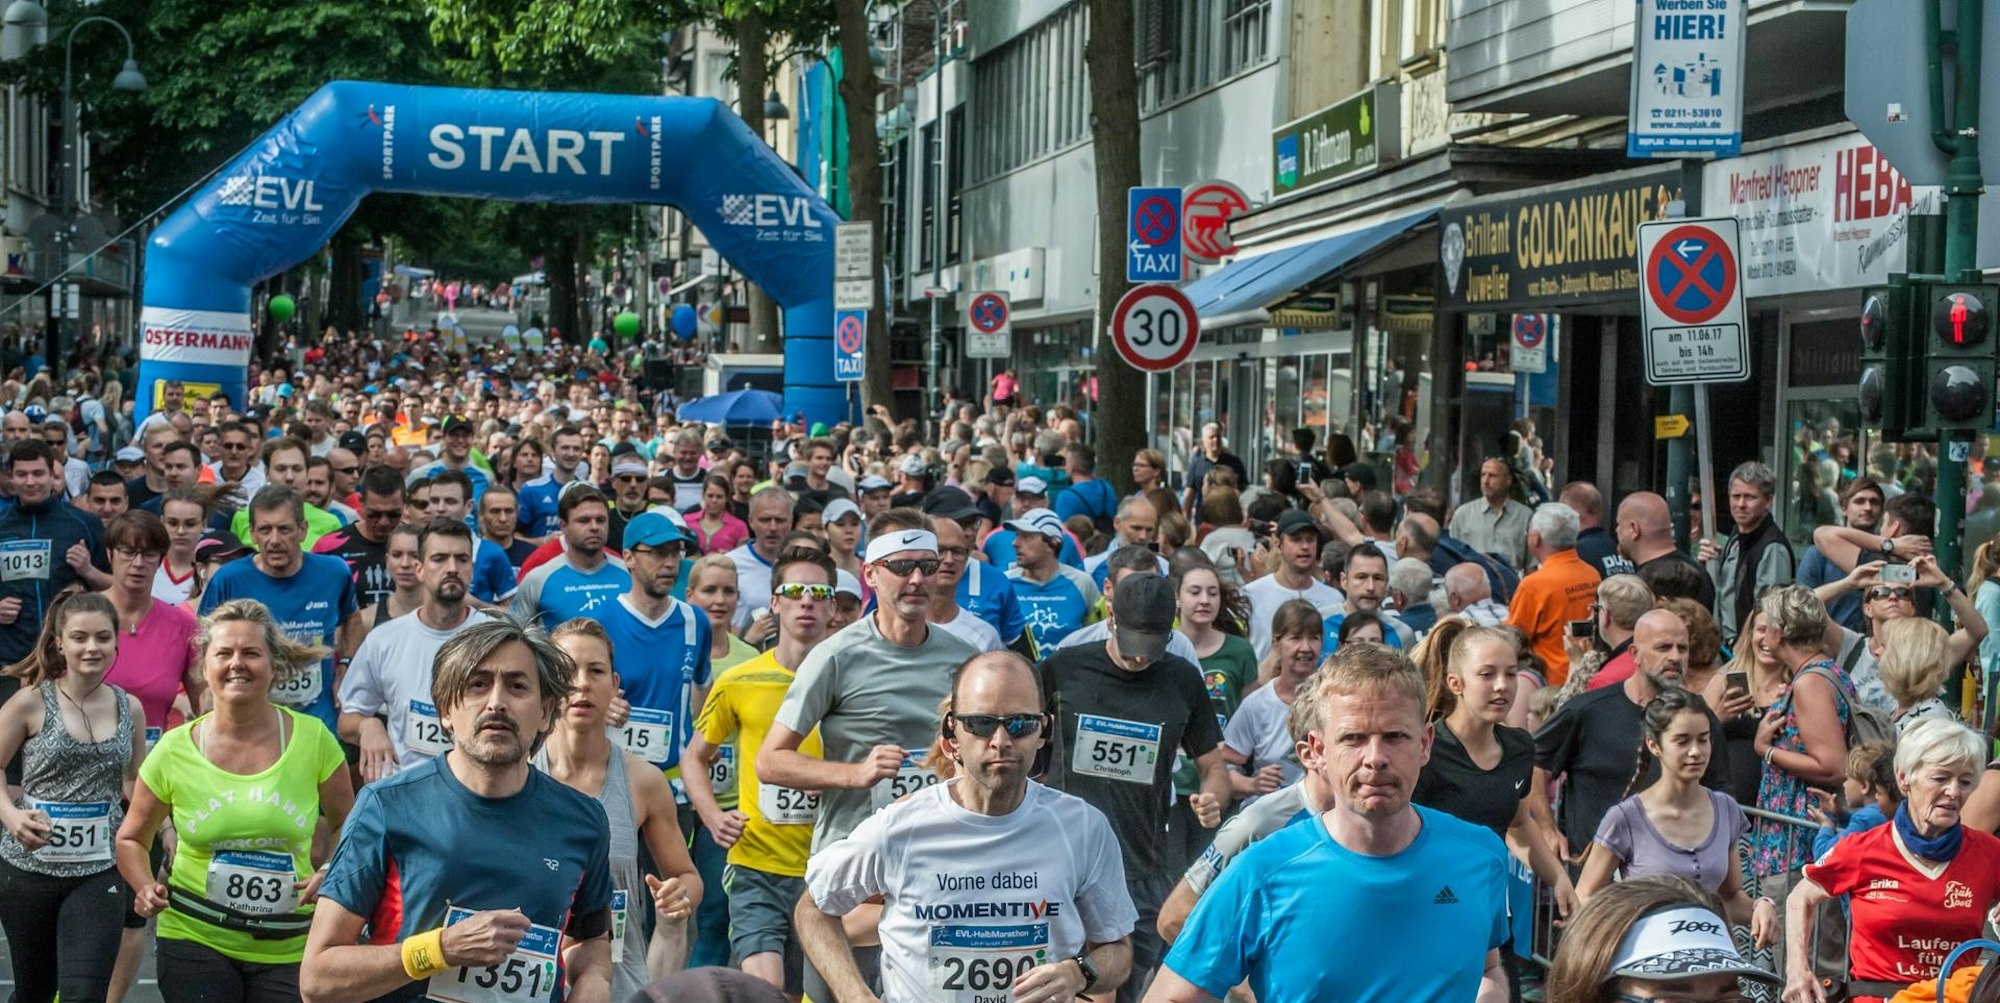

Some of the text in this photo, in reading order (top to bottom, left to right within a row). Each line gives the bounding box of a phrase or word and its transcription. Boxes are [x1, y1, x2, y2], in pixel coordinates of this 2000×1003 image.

[1655, 15, 1725, 40] HIER!
[1664, 108, 1722, 118] 0211-53610
[383, 105, 395, 180] SPORTPARK
[428, 123, 625, 176] START
[650, 115, 662, 190] SPORTPARK
[254, 176, 323, 212] EVL
[1730, 164, 1821, 205] Manfred Heppner
[253, 210, 277, 224] Zeit
[281, 211, 298, 224] für
[755, 193, 822, 228] EVL
[756, 229, 780, 241] Zeit
[783, 230, 801, 241] für
[1465, 212, 1510, 258] Brillant
[1134, 252, 1176, 273] TAXI
[1466, 265, 1510, 302] Juwelier
[1131, 308, 1181, 347] 30
[1272, 312, 1337, 326] thmann
[145, 329, 251, 351] OSTERMANN
[1668, 328, 1722, 342] am 11.06.17
[1679, 345, 1714, 358] bis 14h
[838, 358, 863, 374] TAXI
[3, 554, 43, 571] 1013
[623, 727, 650, 748] 15
[1092, 740, 1138, 767] 551
[710, 764, 727, 782] 9
[1094, 764, 1132, 776] Christoph
[776, 789, 819, 810] 529
[186, 787, 306, 834] PLAY HARD
[50, 824, 96, 848] S51
[226, 873, 282, 903] 863
[936, 872, 1038, 891] Vorne dabei
[1870, 879, 1899, 889] Erika
[1945, 880, 1973, 898] Früh
[229, 900, 273, 914] Katharina
[915, 898, 1060, 920] MOMENTIVE
[1944, 894, 1972, 908] Sport
[955, 928, 1029, 939] EVL-HalbMarathon
[1898, 935, 1961, 950] Laufen
[1917, 952, 1945, 965] für
[457, 957, 542, 998] 1351
[942, 954, 1036, 991] 2690
[974, 994, 1007, 1003] David
